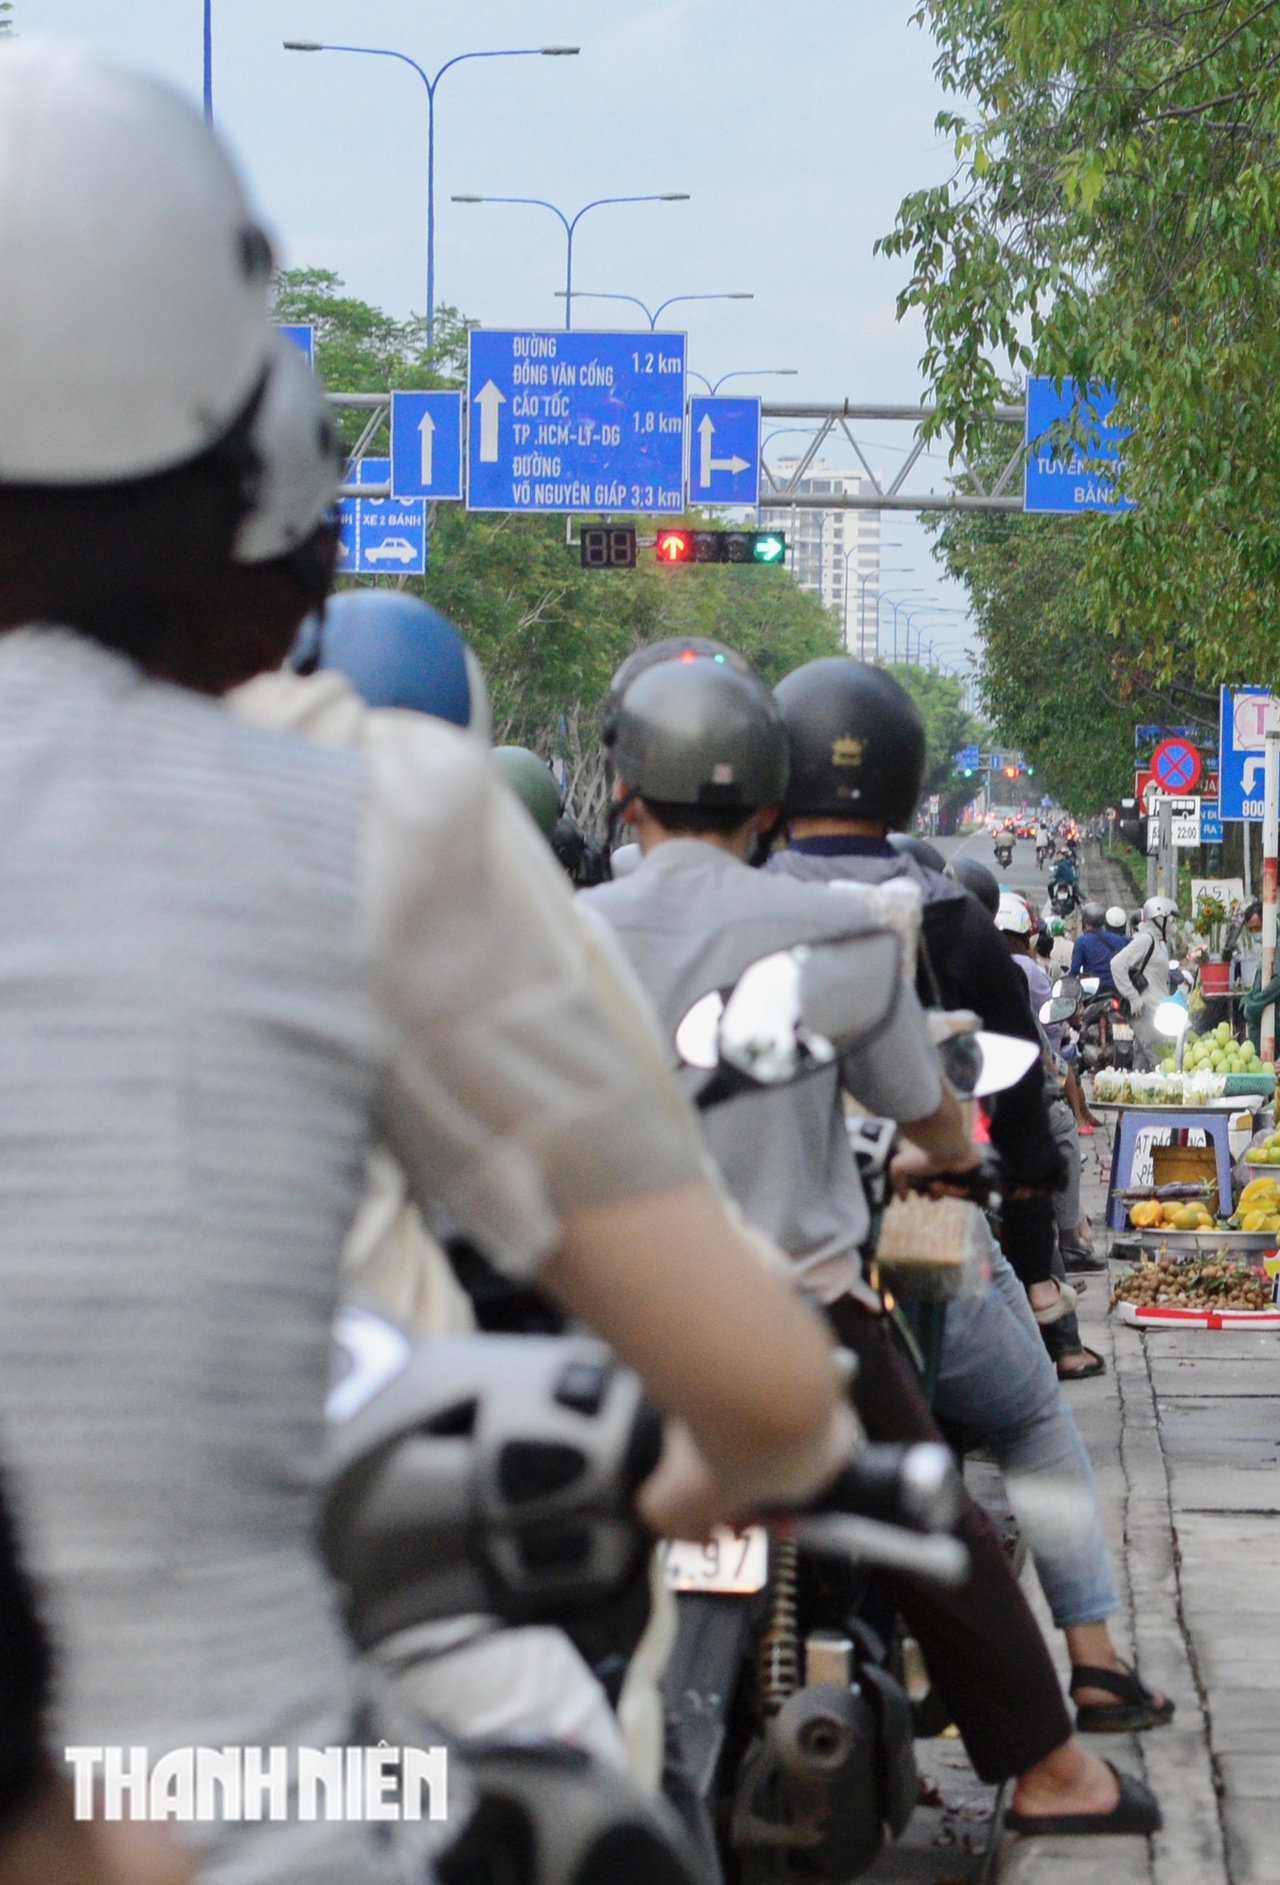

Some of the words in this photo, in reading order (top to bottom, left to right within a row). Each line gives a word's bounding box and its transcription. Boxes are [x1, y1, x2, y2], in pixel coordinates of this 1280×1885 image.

[513, 333, 557, 358] ĐƯỜNG
[513, 358, 548, 385] ĐỒNG
[551, 361, 576, 386] VĂN
[580, 358, 614, 387] CỐNG
[658, 352, 682, 374] km
[542, 389, 570, 417] TỐC
[659, 411, 682, 433] km
[512, 450, 562, 477] ĐƯỜNG
[512, 480, 531, 505] VÕ
[535, 480, 591, 506] NGUYÊN
[595, 480, 627, 506] GIÁP
[658, 486, 681, 507] km
[363, 514, 378, 526] XE
[380, 514, 386, 526] 2
[388, 512, 421, 526] BÁNH
[1177, 826, 1197, 839] 22:00
